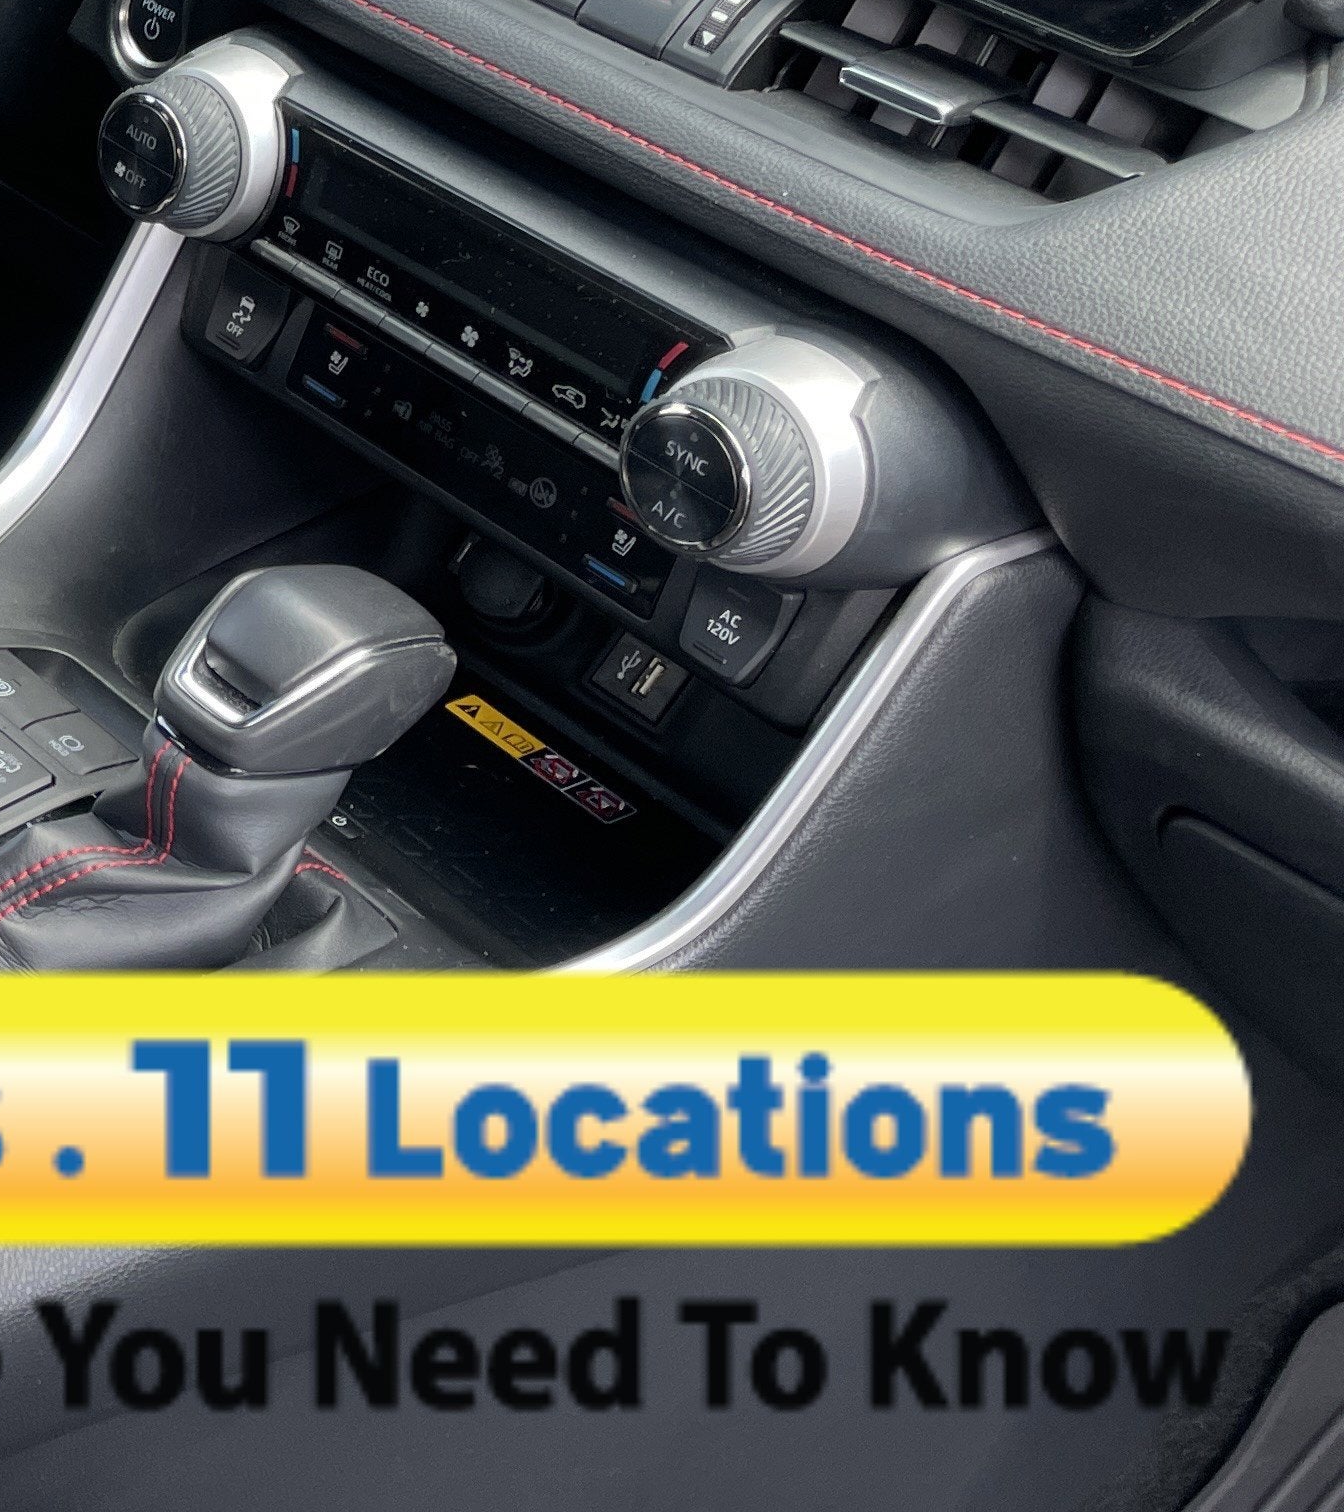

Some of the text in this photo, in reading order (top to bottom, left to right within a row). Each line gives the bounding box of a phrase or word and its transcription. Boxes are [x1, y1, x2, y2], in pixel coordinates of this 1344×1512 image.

[125, 123, 157, 150] AUTO
[124, 168, 147, 189] OFF
[365, 264, 391, 288] ECO
[225, 321, 245, 339] OFF
[665, 439, 709, 477] SYNC
[651, 500, 688, 530] A/C
[719, 609, 742, 629] AC
[706, 619, 740, 645] 120V
